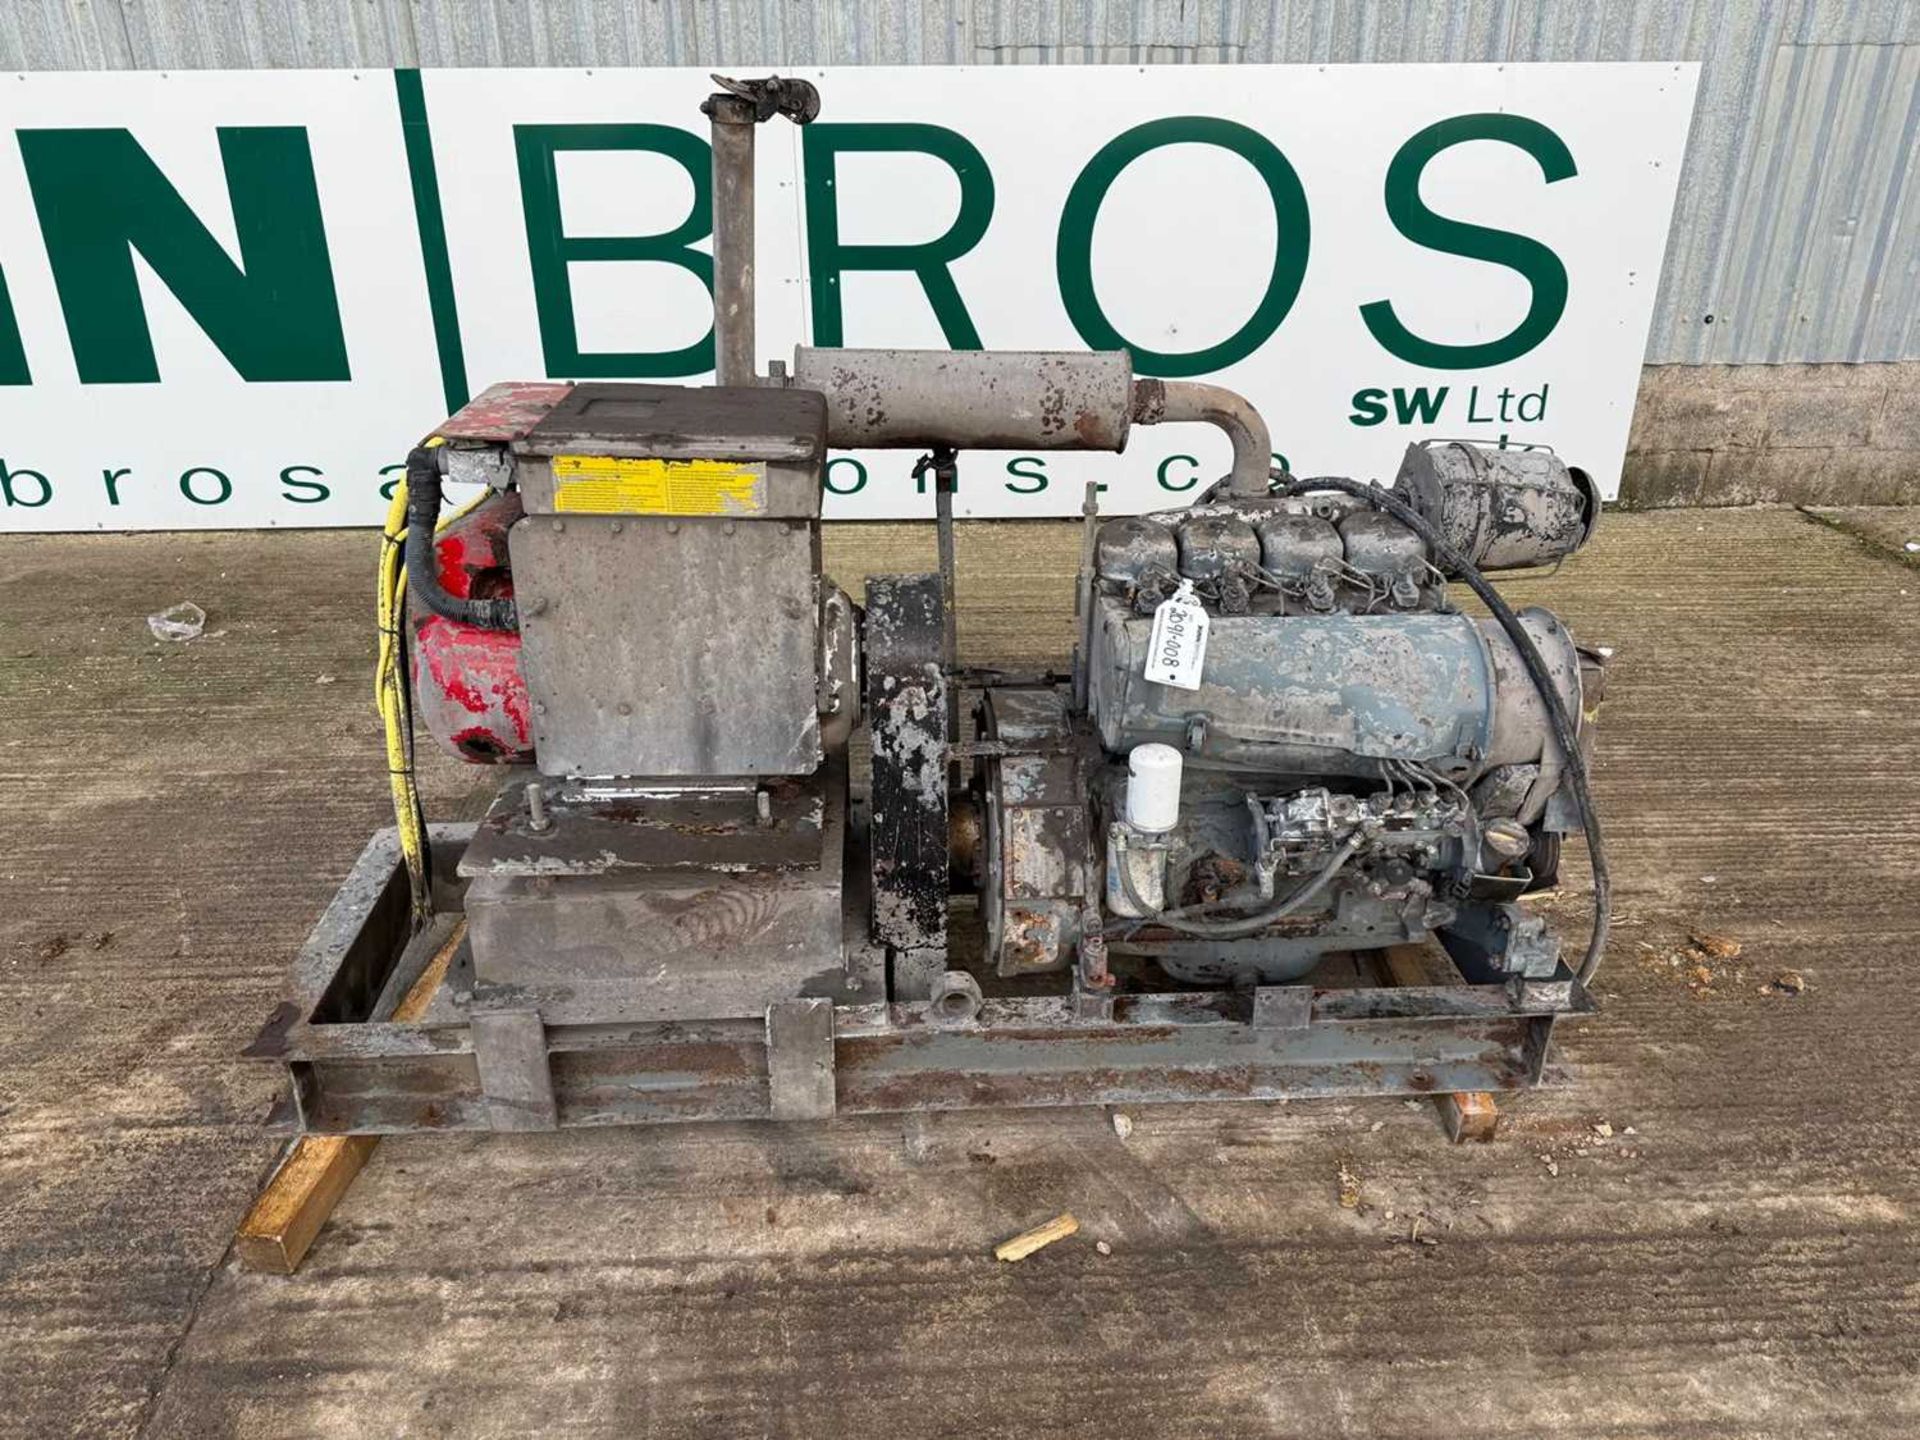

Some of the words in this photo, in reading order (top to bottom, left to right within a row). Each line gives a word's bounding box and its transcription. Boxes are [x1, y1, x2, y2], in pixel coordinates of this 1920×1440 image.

[0, 126, 352, 386] N
[512, 112, 1578, 378] BROS
[1467, 384, 1549, 423] Ltd
